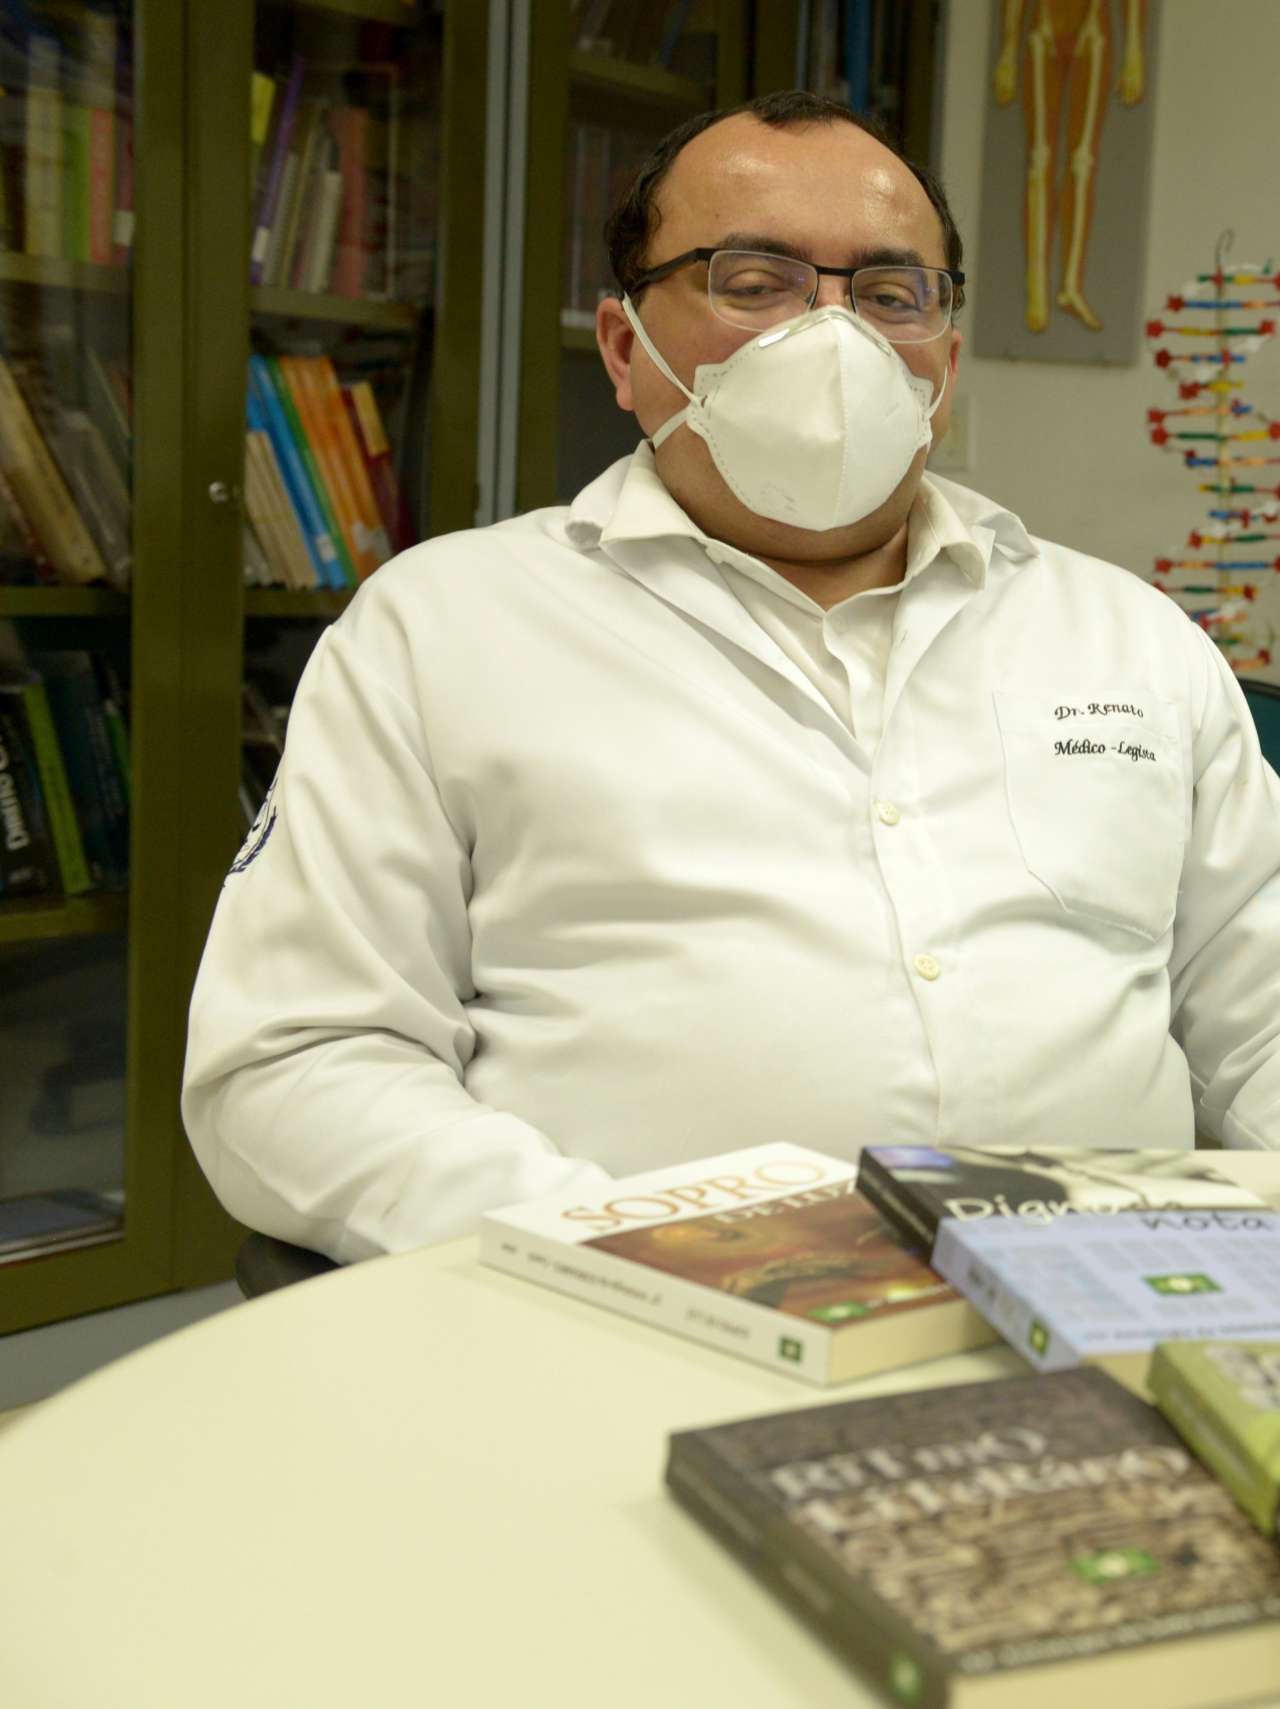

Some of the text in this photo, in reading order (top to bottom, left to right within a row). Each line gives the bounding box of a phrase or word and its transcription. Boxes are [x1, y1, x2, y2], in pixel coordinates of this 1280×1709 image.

[1054, 701, 1144, 721] Dr. Renato
[1054, 738, 1106, 756] Médico
[562, 1161, 826, 1231] SOPRO
